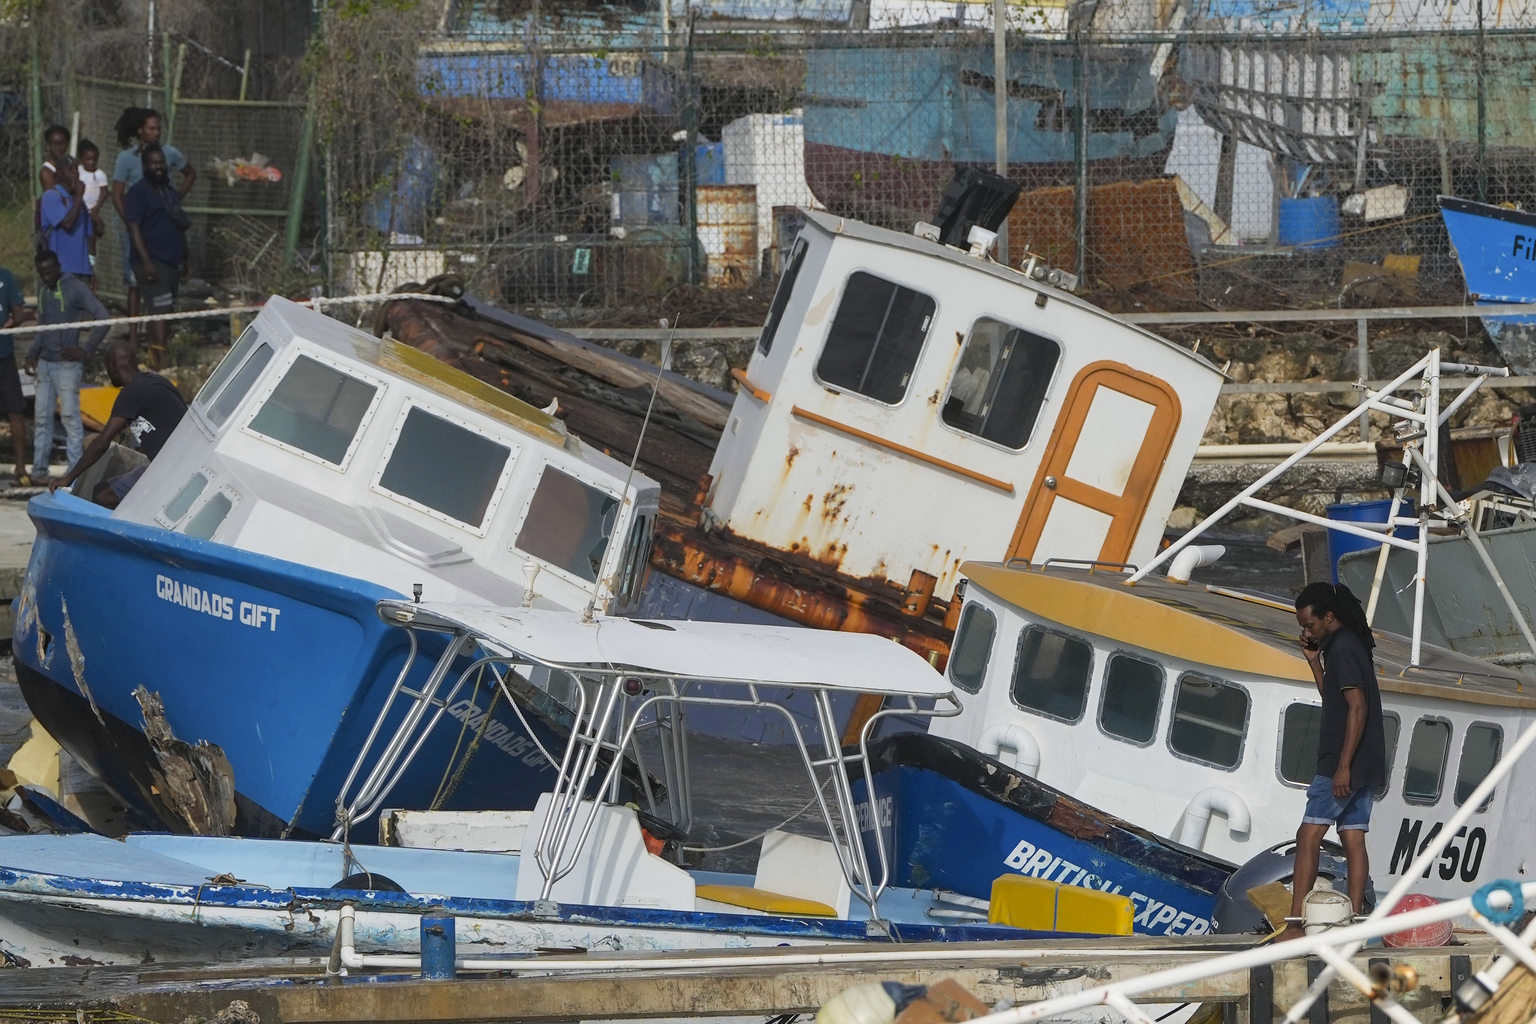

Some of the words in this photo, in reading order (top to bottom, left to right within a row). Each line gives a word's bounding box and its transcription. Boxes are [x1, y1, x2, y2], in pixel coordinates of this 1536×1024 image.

[156, 573, 234, 621] GRANDADS
[240, 601, 281, 632] GIFT
[1128, 891, 1211, 937] EXPER
